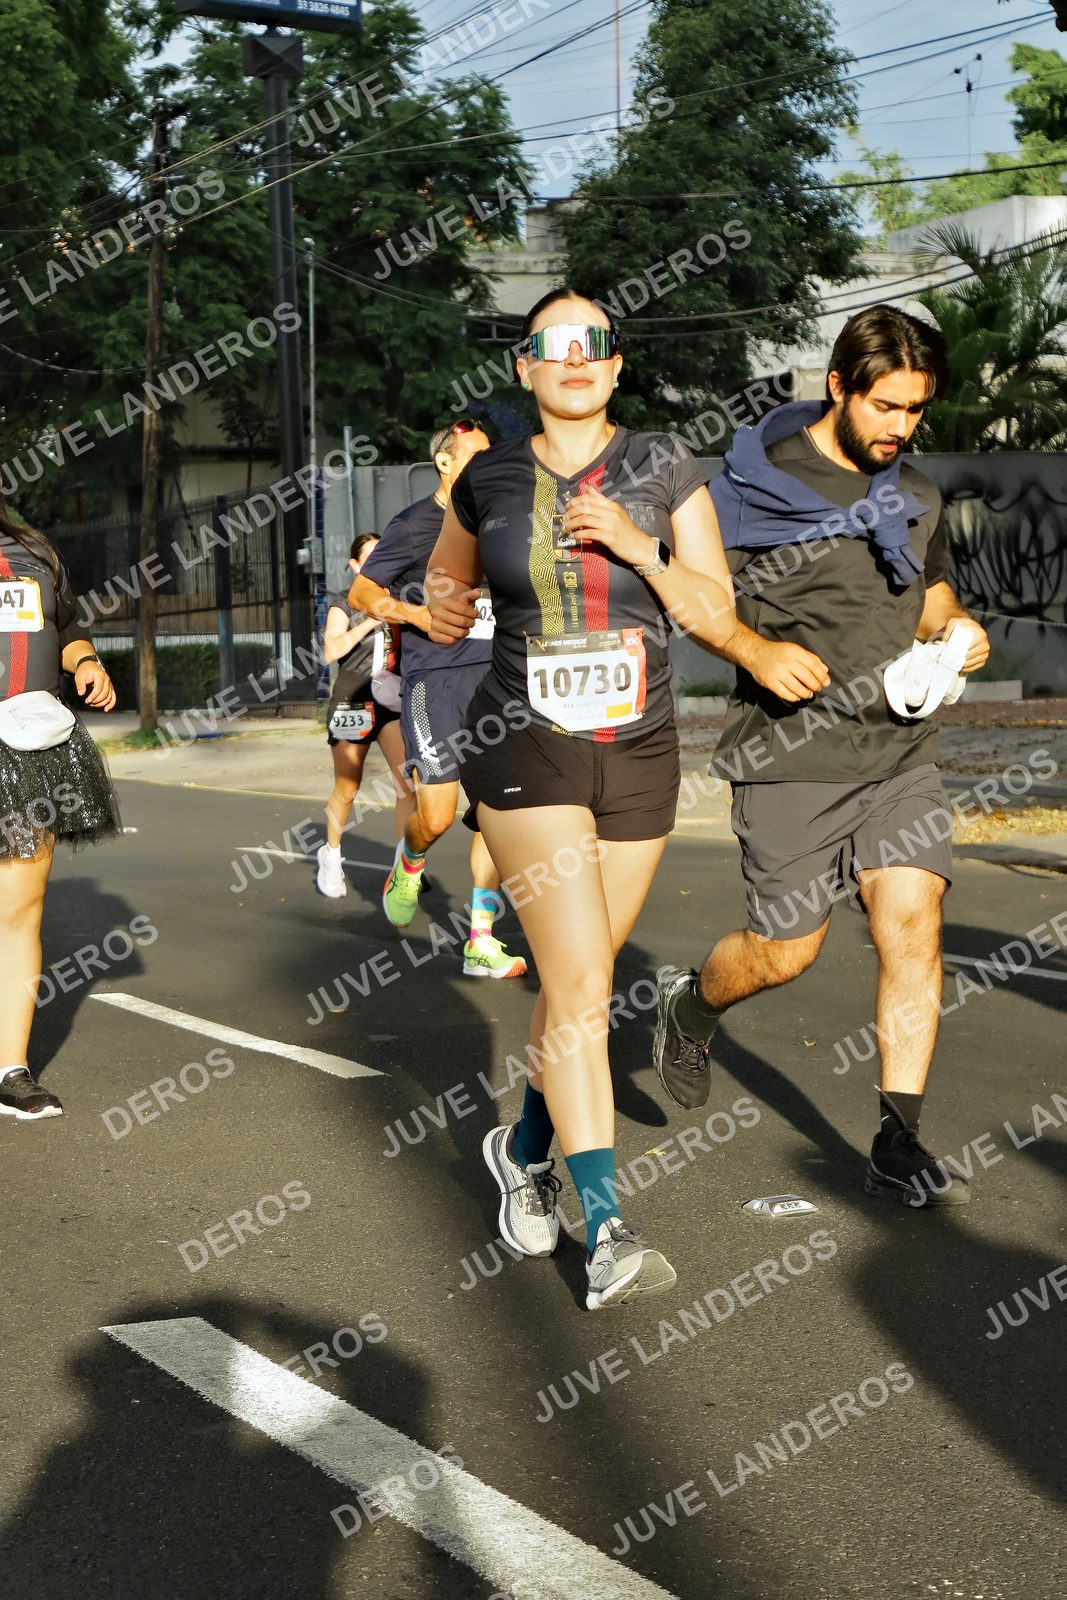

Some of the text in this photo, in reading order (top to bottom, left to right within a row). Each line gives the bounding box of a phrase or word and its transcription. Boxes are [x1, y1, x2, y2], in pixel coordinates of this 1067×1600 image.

[0, 588, 25, 608] 47
[533, 662, 632, 699] 10730
[333, 715, 364, 728] 9233
